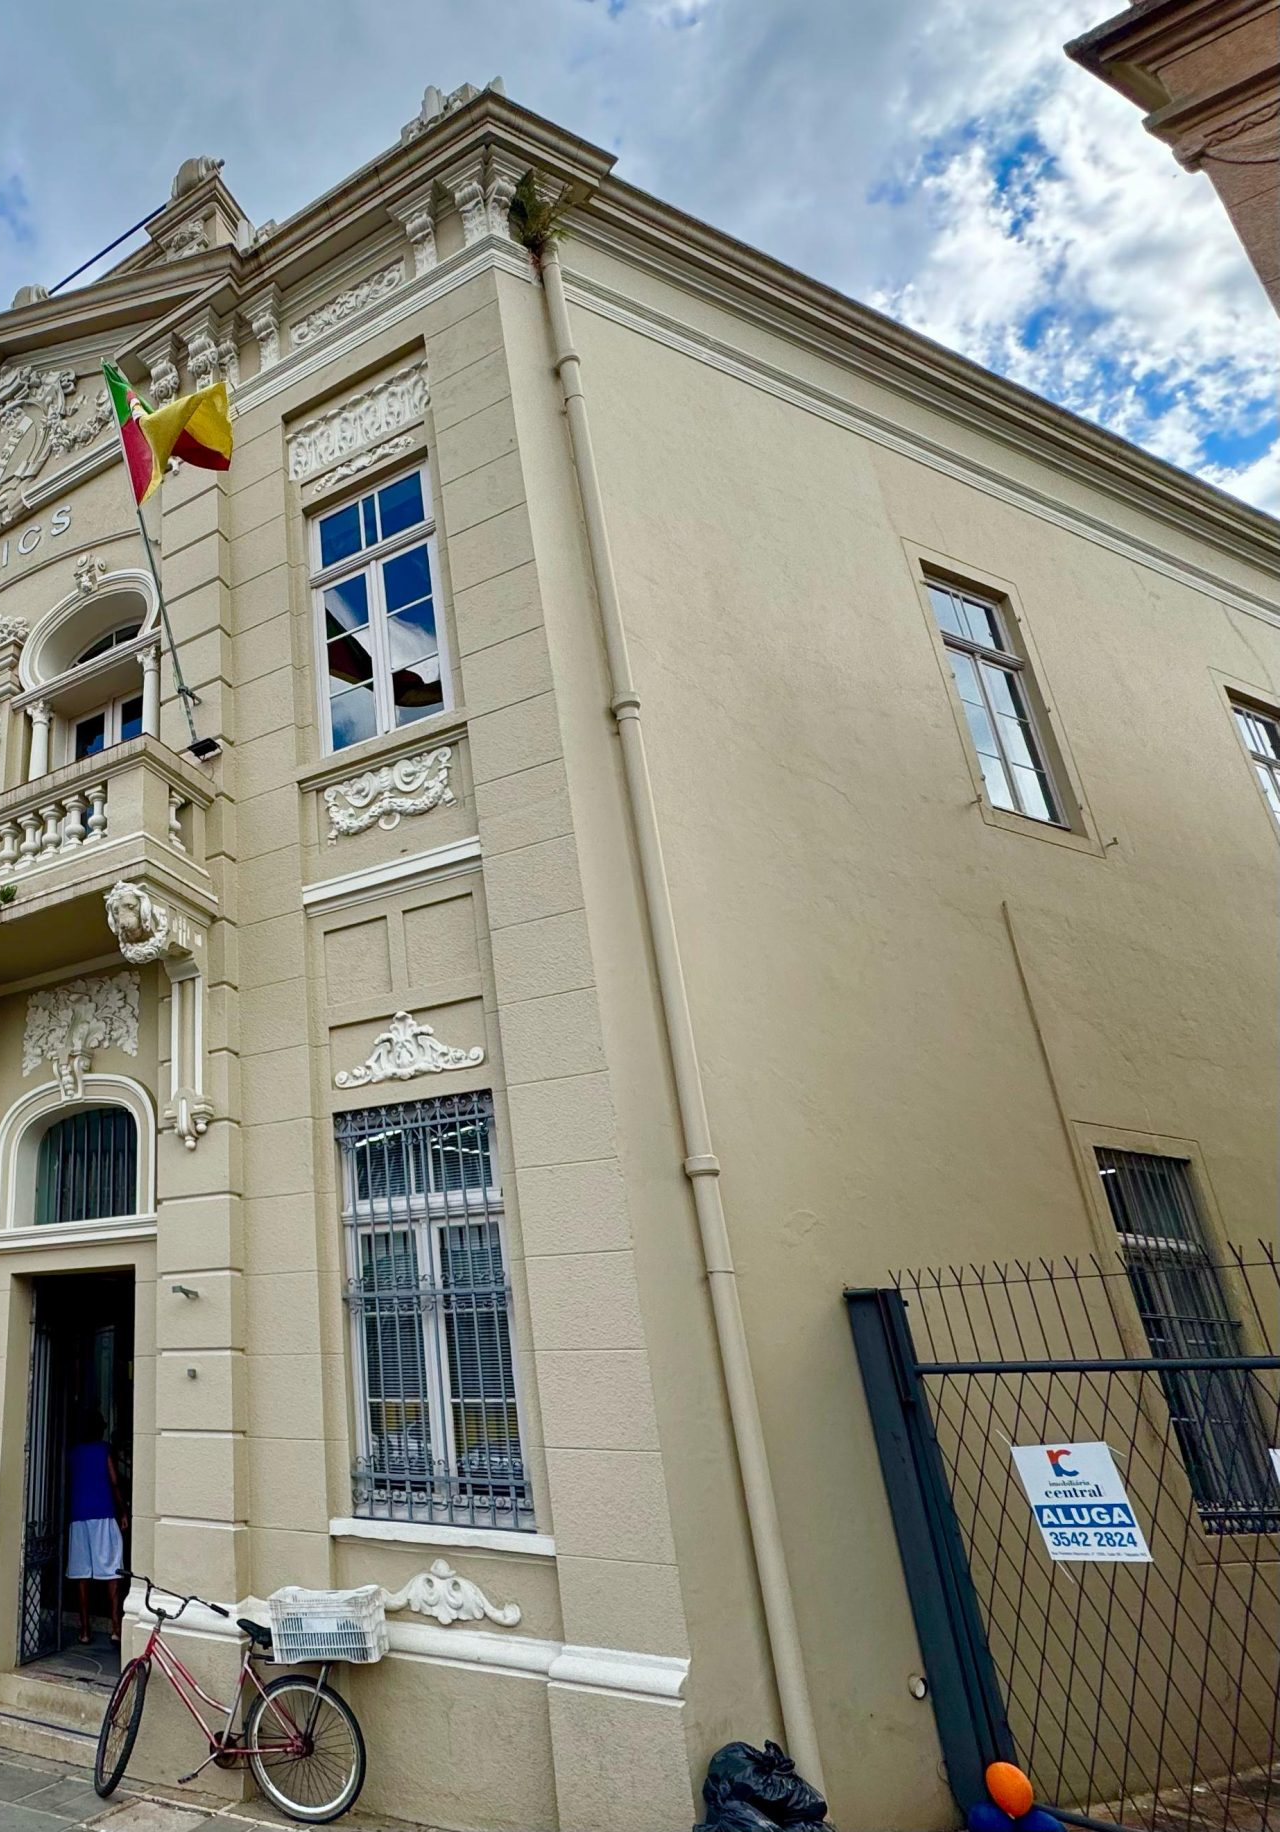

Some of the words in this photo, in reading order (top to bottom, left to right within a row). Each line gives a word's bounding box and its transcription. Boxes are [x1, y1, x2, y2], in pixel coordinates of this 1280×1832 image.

[1044, 1484, 1103, 1499] central
[1042, 1507, 1133, 1525] ALUGA
[1049, 1531, 1091, 1548] 3542
[1094, 1531, 1138, 1548] 2824
